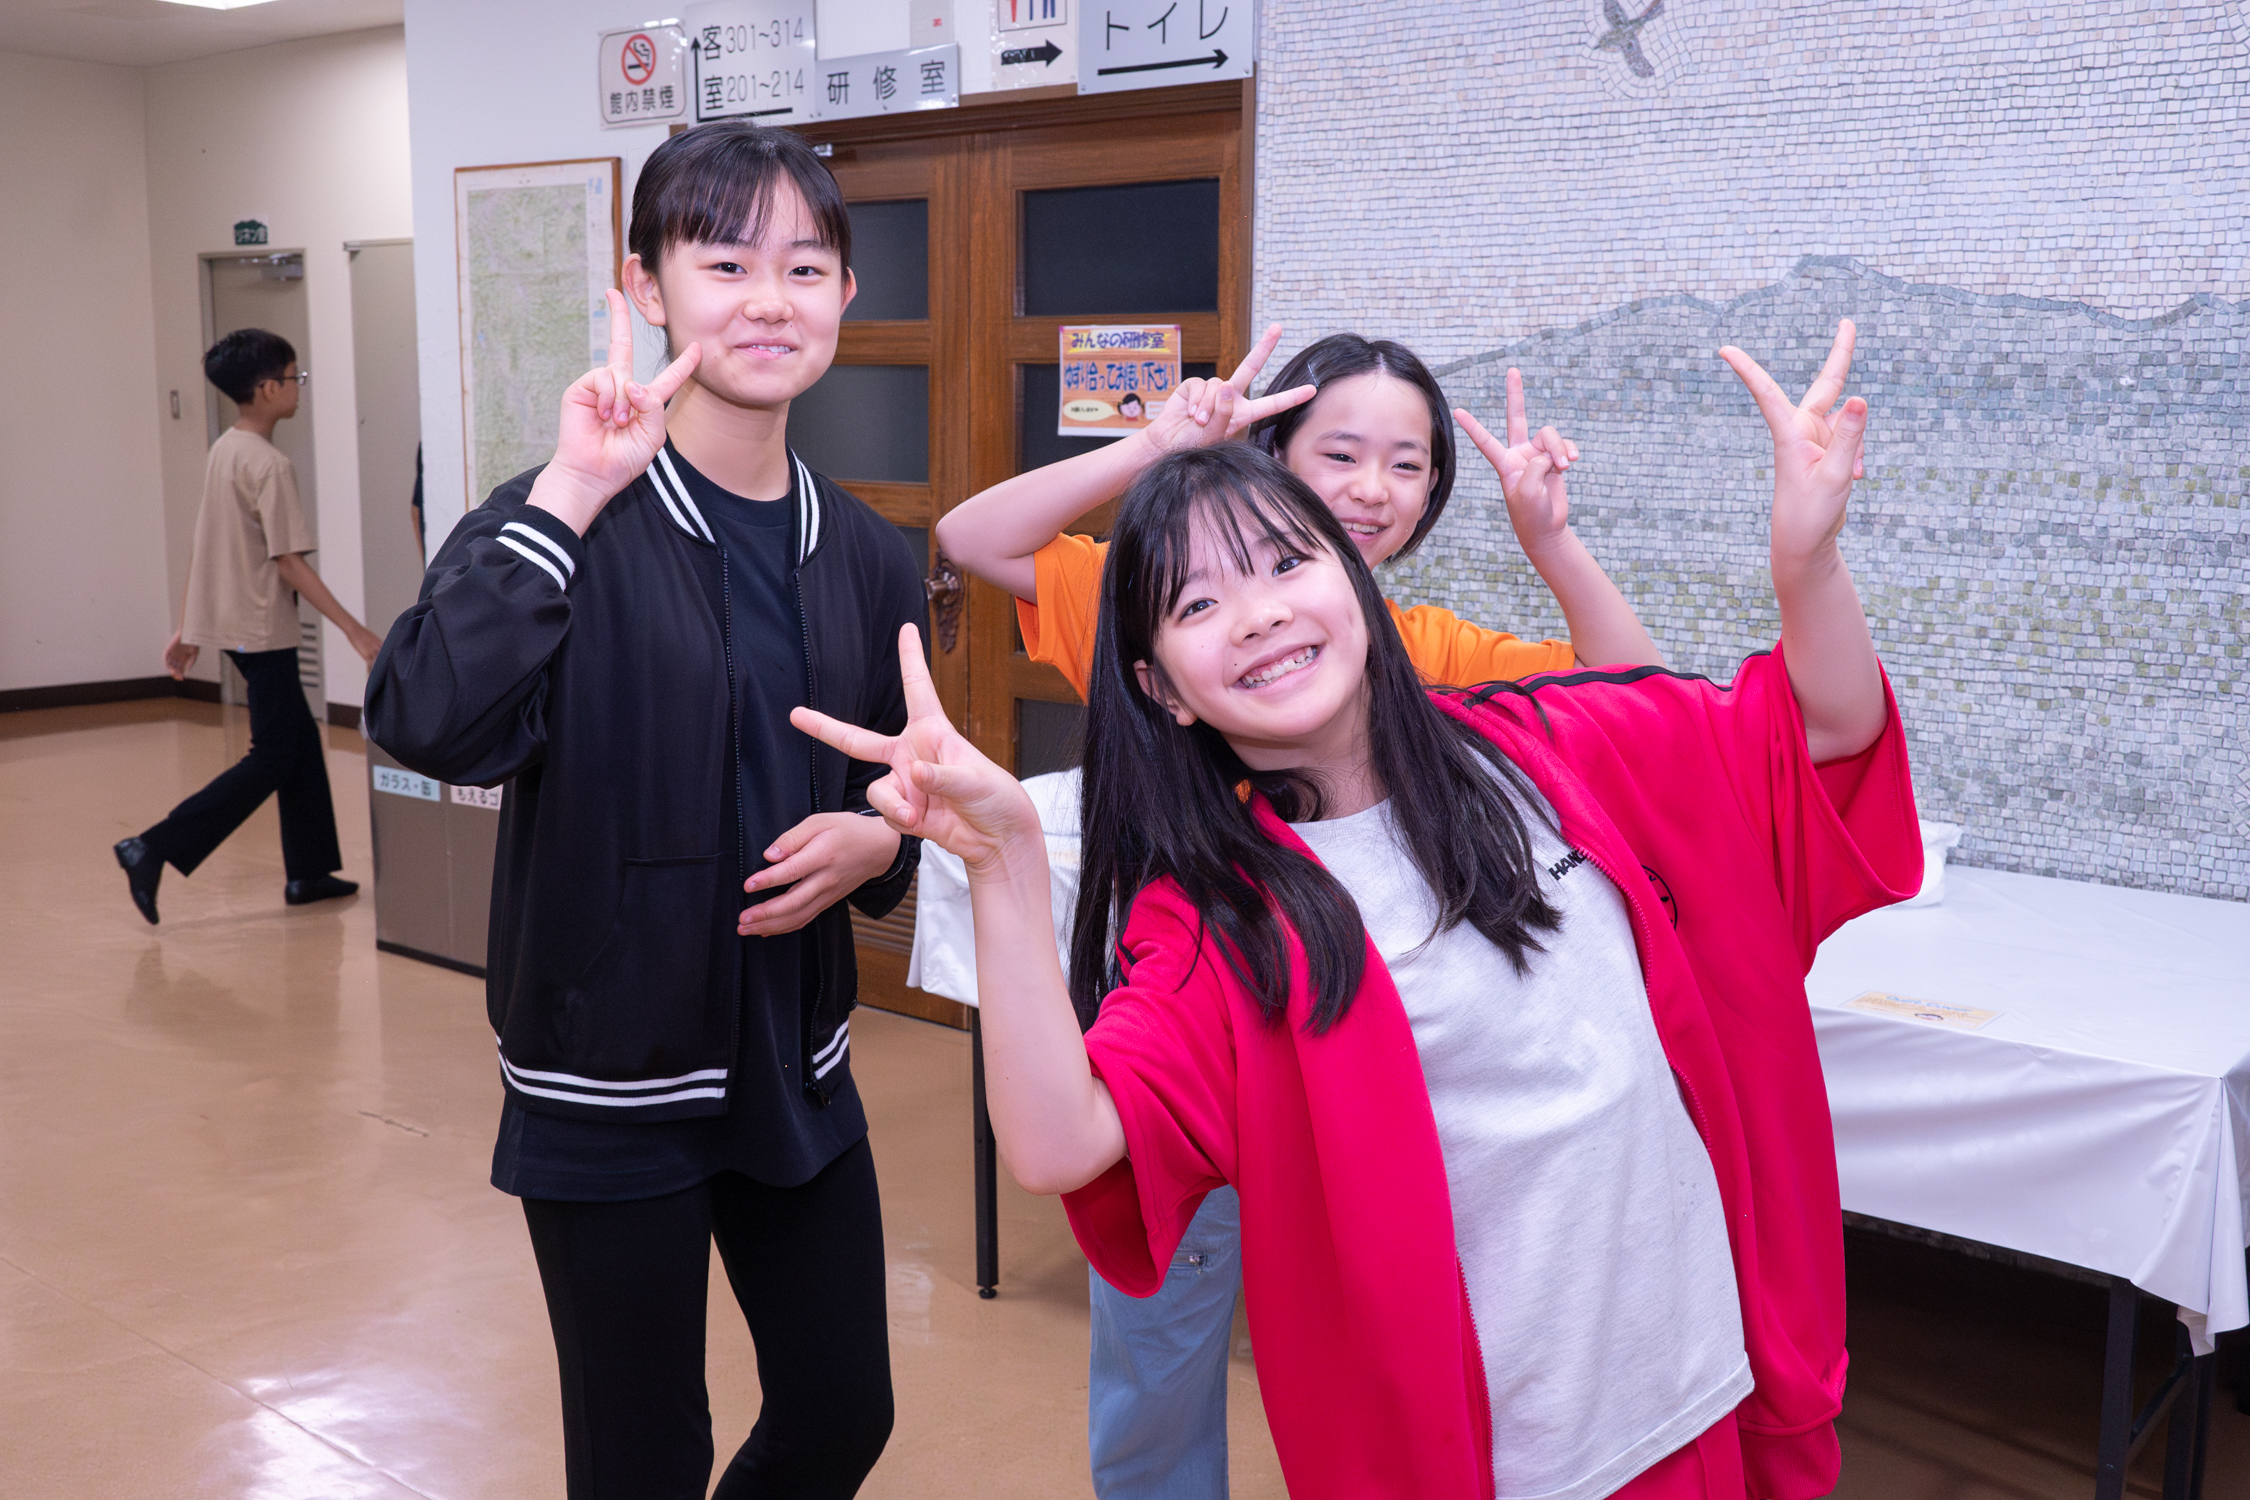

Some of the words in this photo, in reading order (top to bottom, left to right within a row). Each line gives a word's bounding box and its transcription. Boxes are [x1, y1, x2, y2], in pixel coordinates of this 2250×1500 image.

[1106, 0, 1229, 51] トイレ
[610, 85, 675, 115] 館内禁煙
[826, 59, 947, 106] 研修室
[1070, 331, 1166, 349] みんなの研修室
